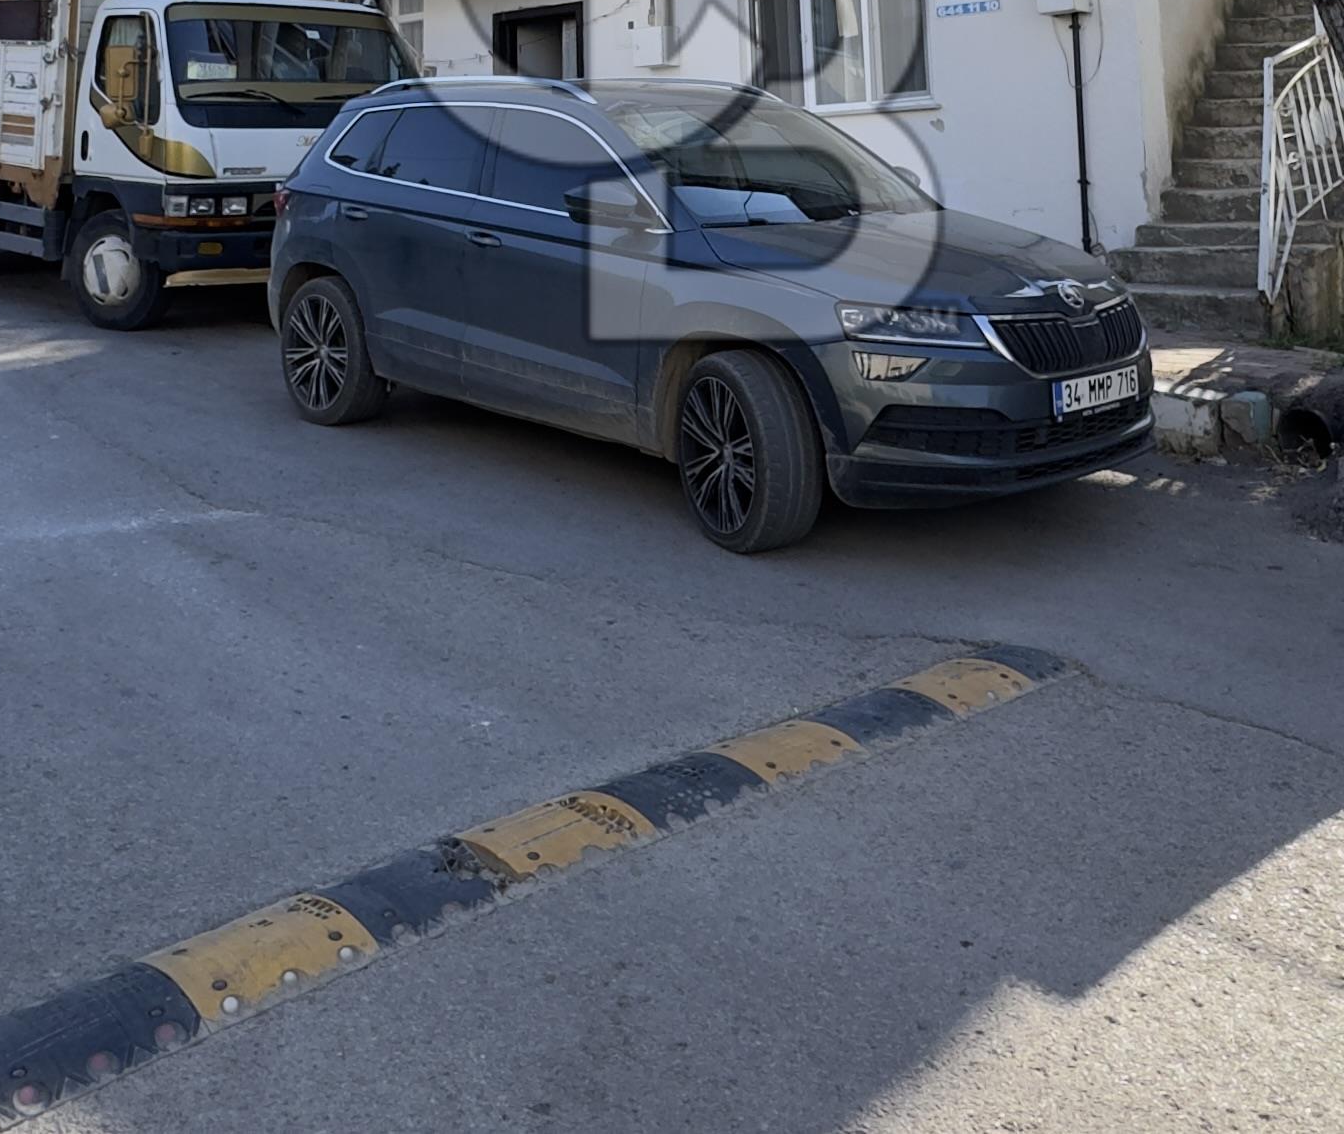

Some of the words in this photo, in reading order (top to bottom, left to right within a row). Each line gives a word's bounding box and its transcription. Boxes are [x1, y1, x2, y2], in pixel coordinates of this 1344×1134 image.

[1064, 382, 1081, 408] 34
[1088, 375, 1113, 403] MMP
[1117, 369, 1136, 396] 716
